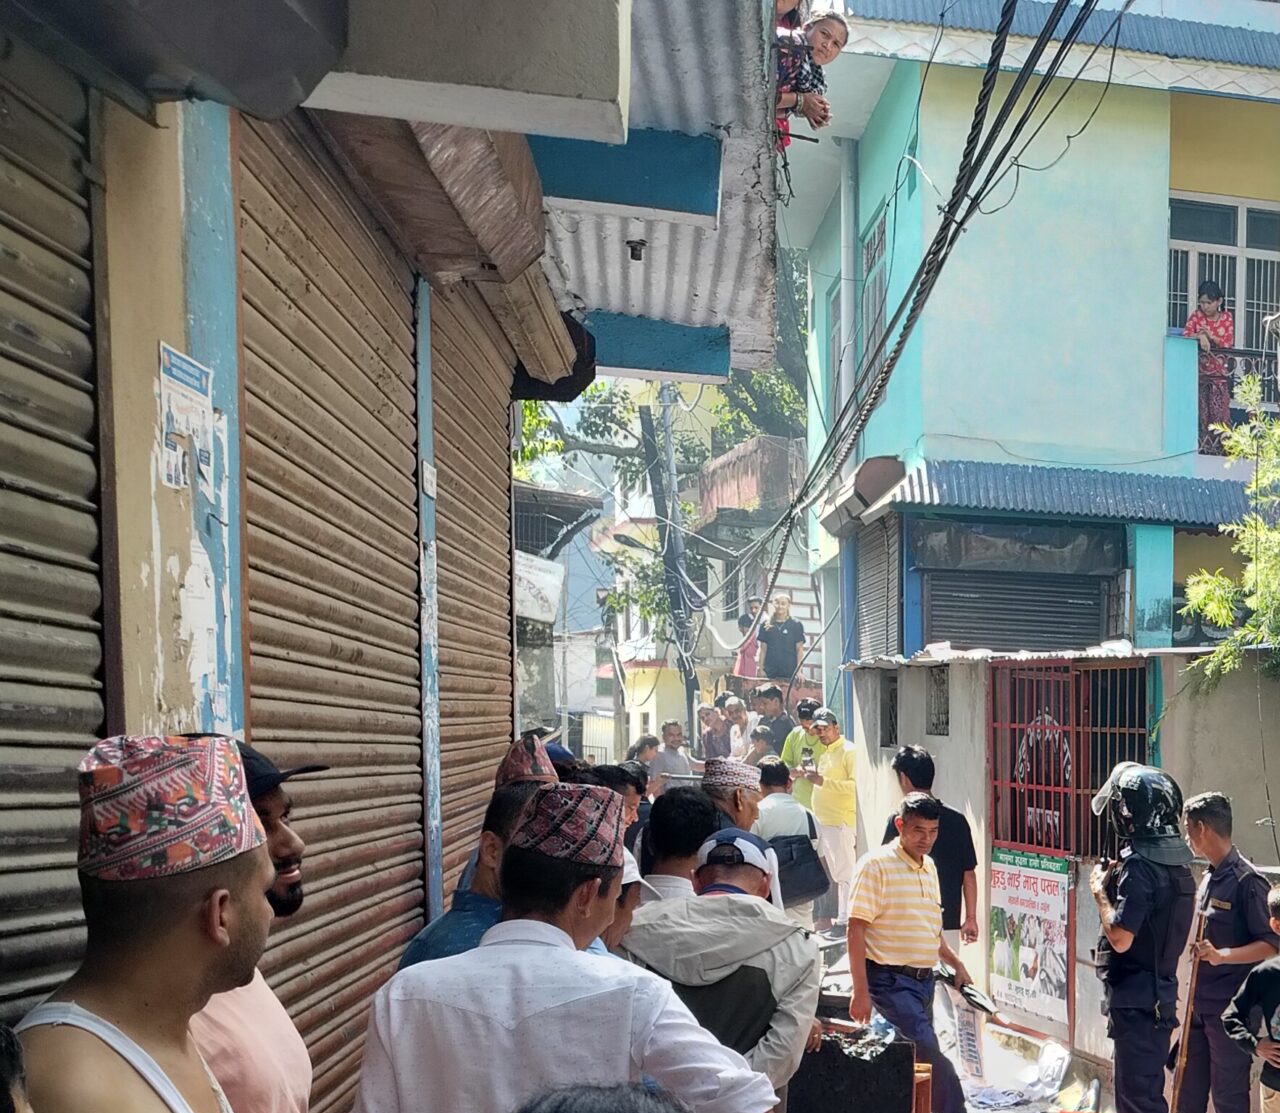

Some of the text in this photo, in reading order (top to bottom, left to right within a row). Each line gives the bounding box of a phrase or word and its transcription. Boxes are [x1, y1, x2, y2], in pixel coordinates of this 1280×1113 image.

[1007, 870, 1021, 890] भाई
[1023, 874, 1038, 897] मासु
[1040, 878, 1060, 896] पसल
